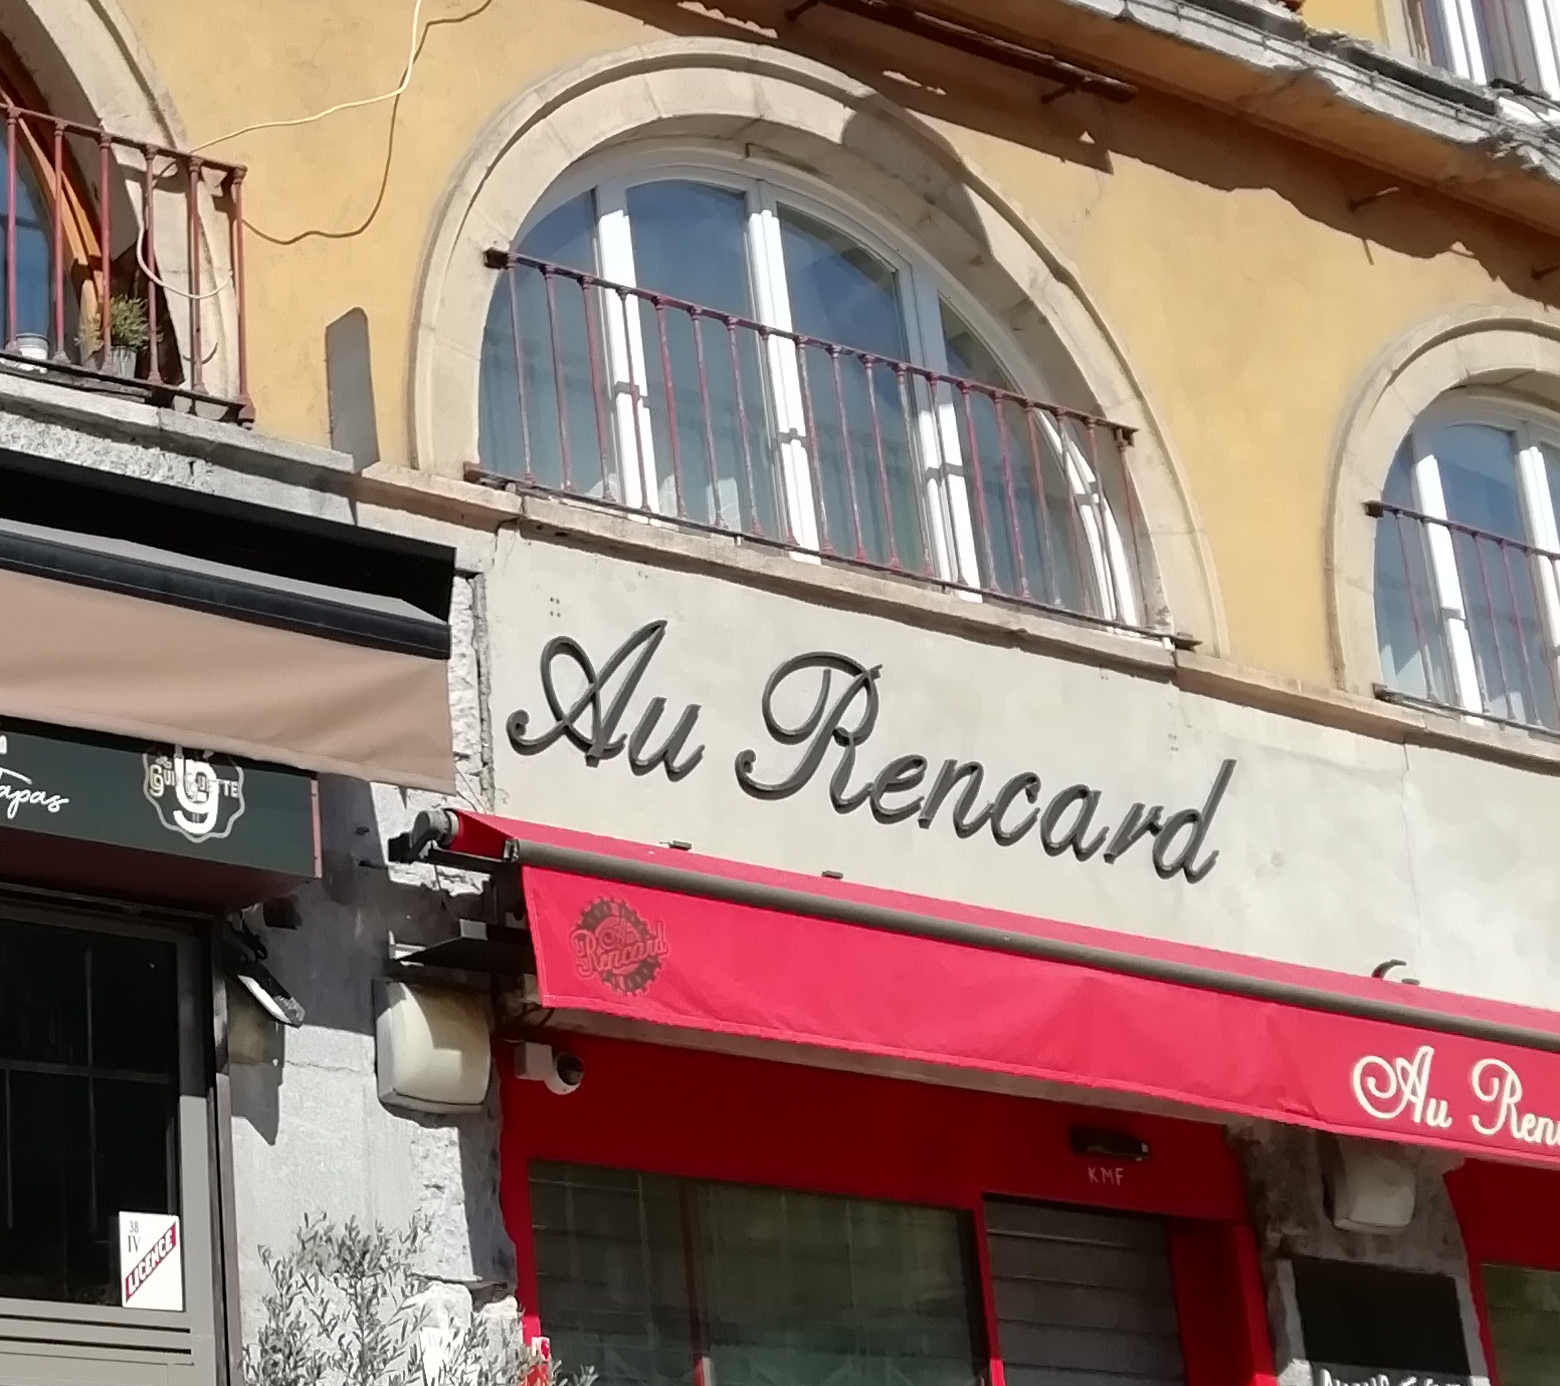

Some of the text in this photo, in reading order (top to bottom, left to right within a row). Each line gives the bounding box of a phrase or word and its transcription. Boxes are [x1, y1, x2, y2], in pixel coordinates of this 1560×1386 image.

[507, 620, 1236, 883] Au Rencard
[1352, 1045, 1560, 1146] Au Ren
[126, 1223, 176, 1301] LICENCE
[129, 1220, 139, 1233] 38
